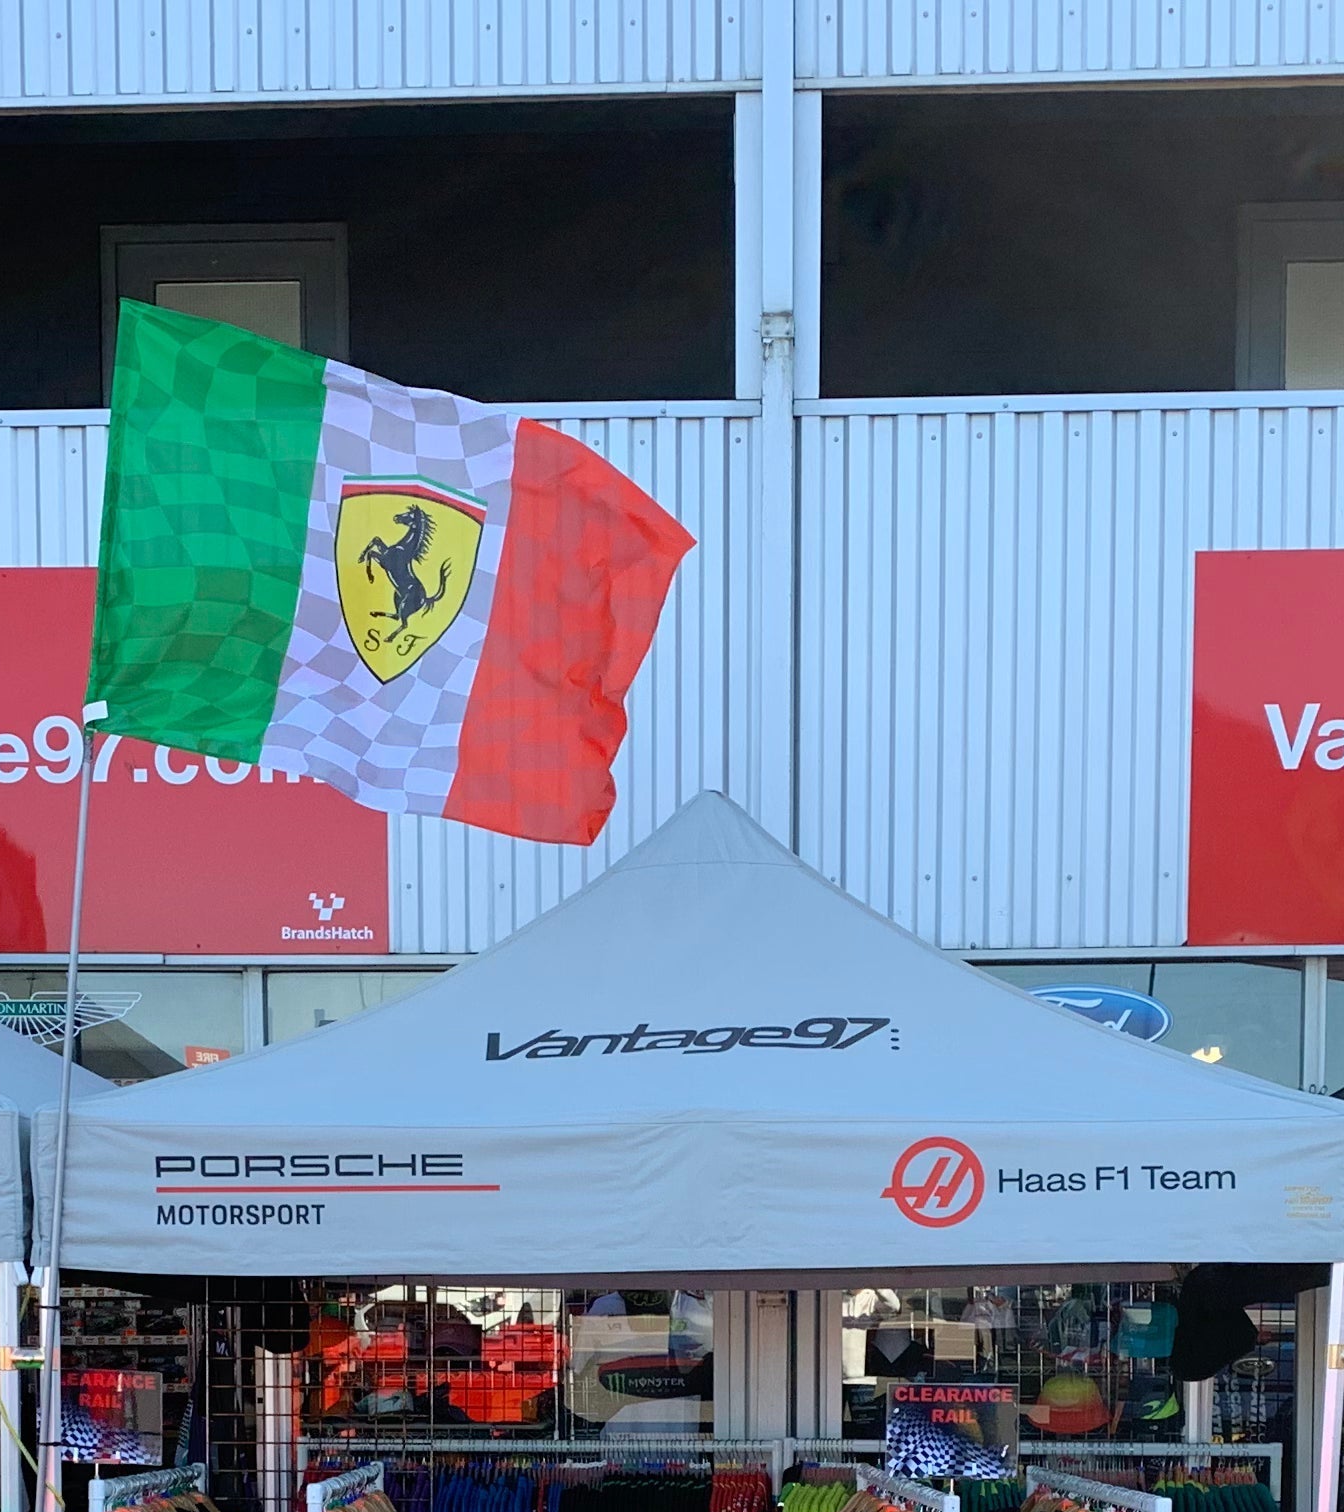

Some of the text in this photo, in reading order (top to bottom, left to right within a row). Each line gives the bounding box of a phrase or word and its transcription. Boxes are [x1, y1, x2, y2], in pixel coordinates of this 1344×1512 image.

[281, 926, 374, 940] BrandsHatch
[18, 1003, 68, 1015] MARTIN
[485, 1016, 892, 1061] Vantage97
[155, 1153, 464, 1179] PORSCHE
[998, 1165, 1237, 1192] Haas F1 Team
[156, 1203, 327, 1226] MOTORSPORT
[628, 1377, 685, 1388] MONSTER
[79, 1393, 122, 1409] RAIL
[894, 1386, 1013, 1403] CLEARANCE
[931, 1408, 977, 1423] RAIL
